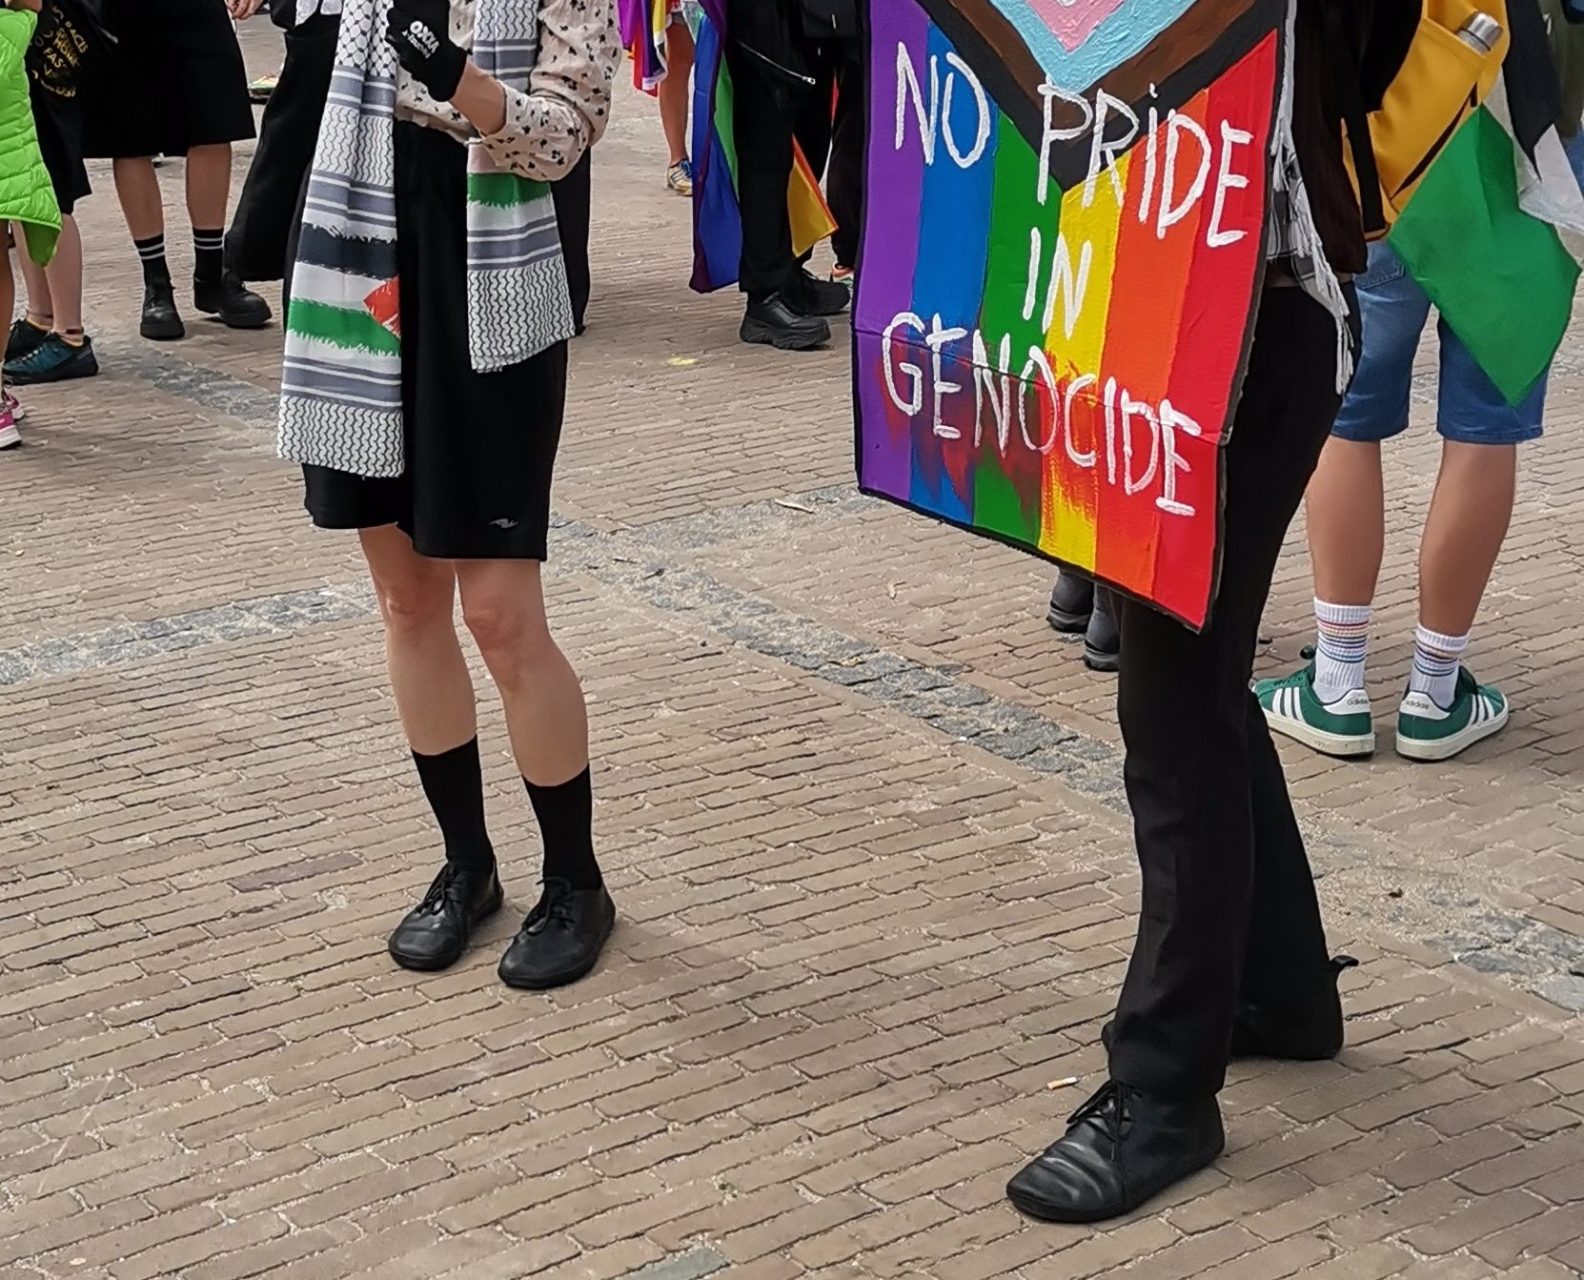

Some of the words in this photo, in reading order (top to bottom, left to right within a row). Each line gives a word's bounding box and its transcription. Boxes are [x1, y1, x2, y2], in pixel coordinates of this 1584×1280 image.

[894, 41, 993, 168] NO
[1022, 226, 1093, 340] IN
[881, 311, 1202, 517] GENOCIDE
